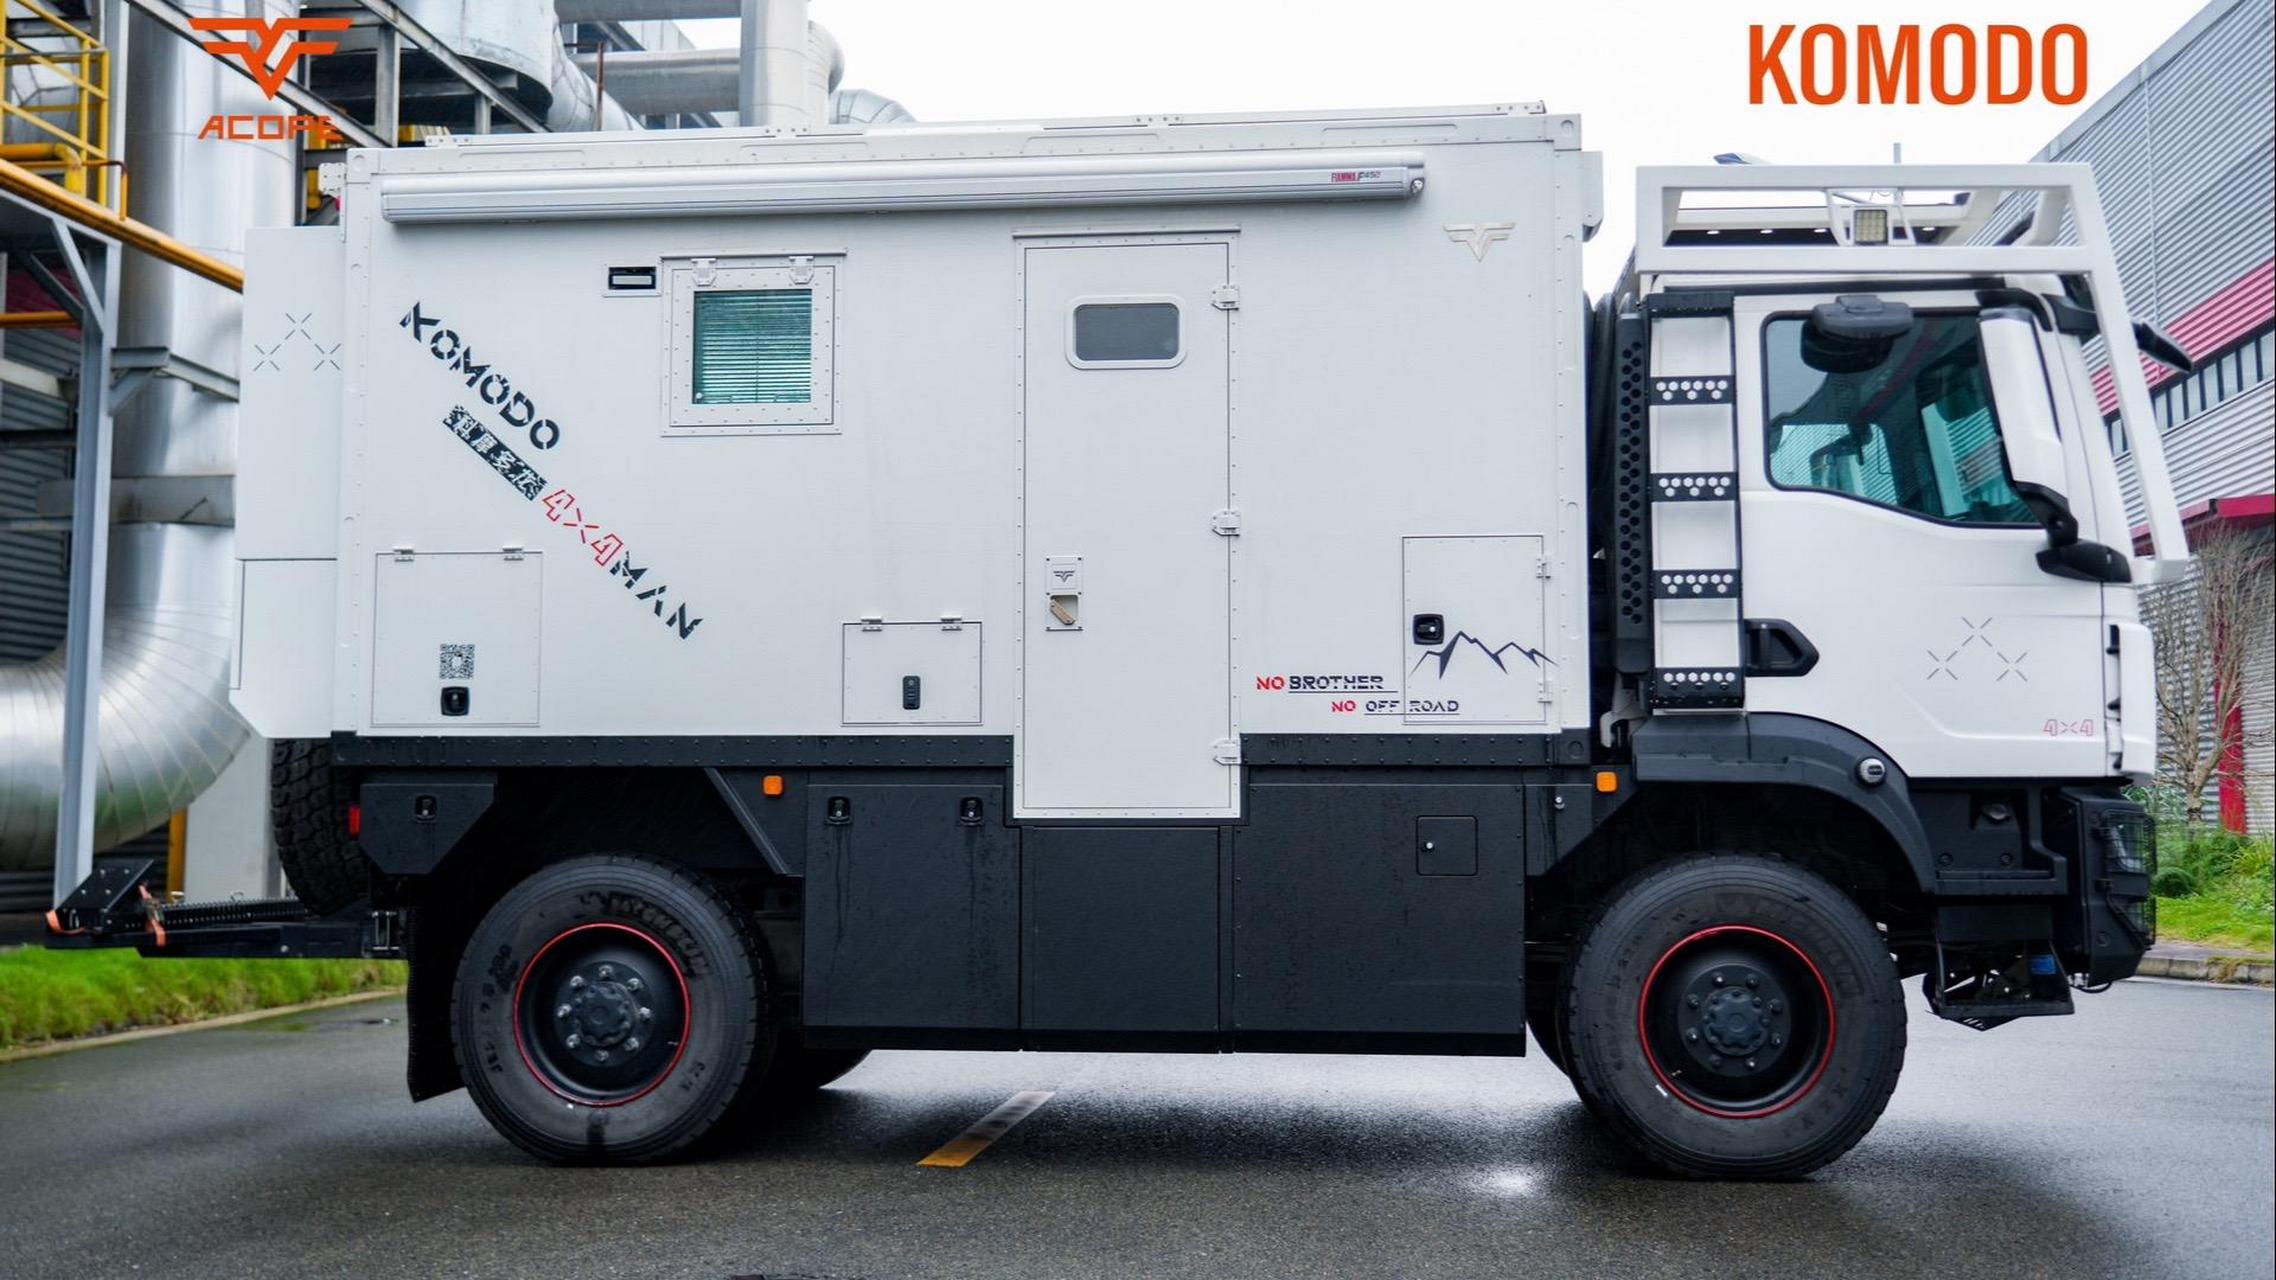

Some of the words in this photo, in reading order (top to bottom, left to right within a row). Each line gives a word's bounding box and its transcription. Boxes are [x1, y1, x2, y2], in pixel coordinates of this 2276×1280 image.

[399, 301, 560, 450] KOMODO
[1257, 676, 1285, 690] NO
[1289, 675, 1384, 690] BROTHER
[1331, 700, 1356, 713] NO
[1365, 700, 1401, 713] OFF
[1409, 700, 1460, 713] ROAD
